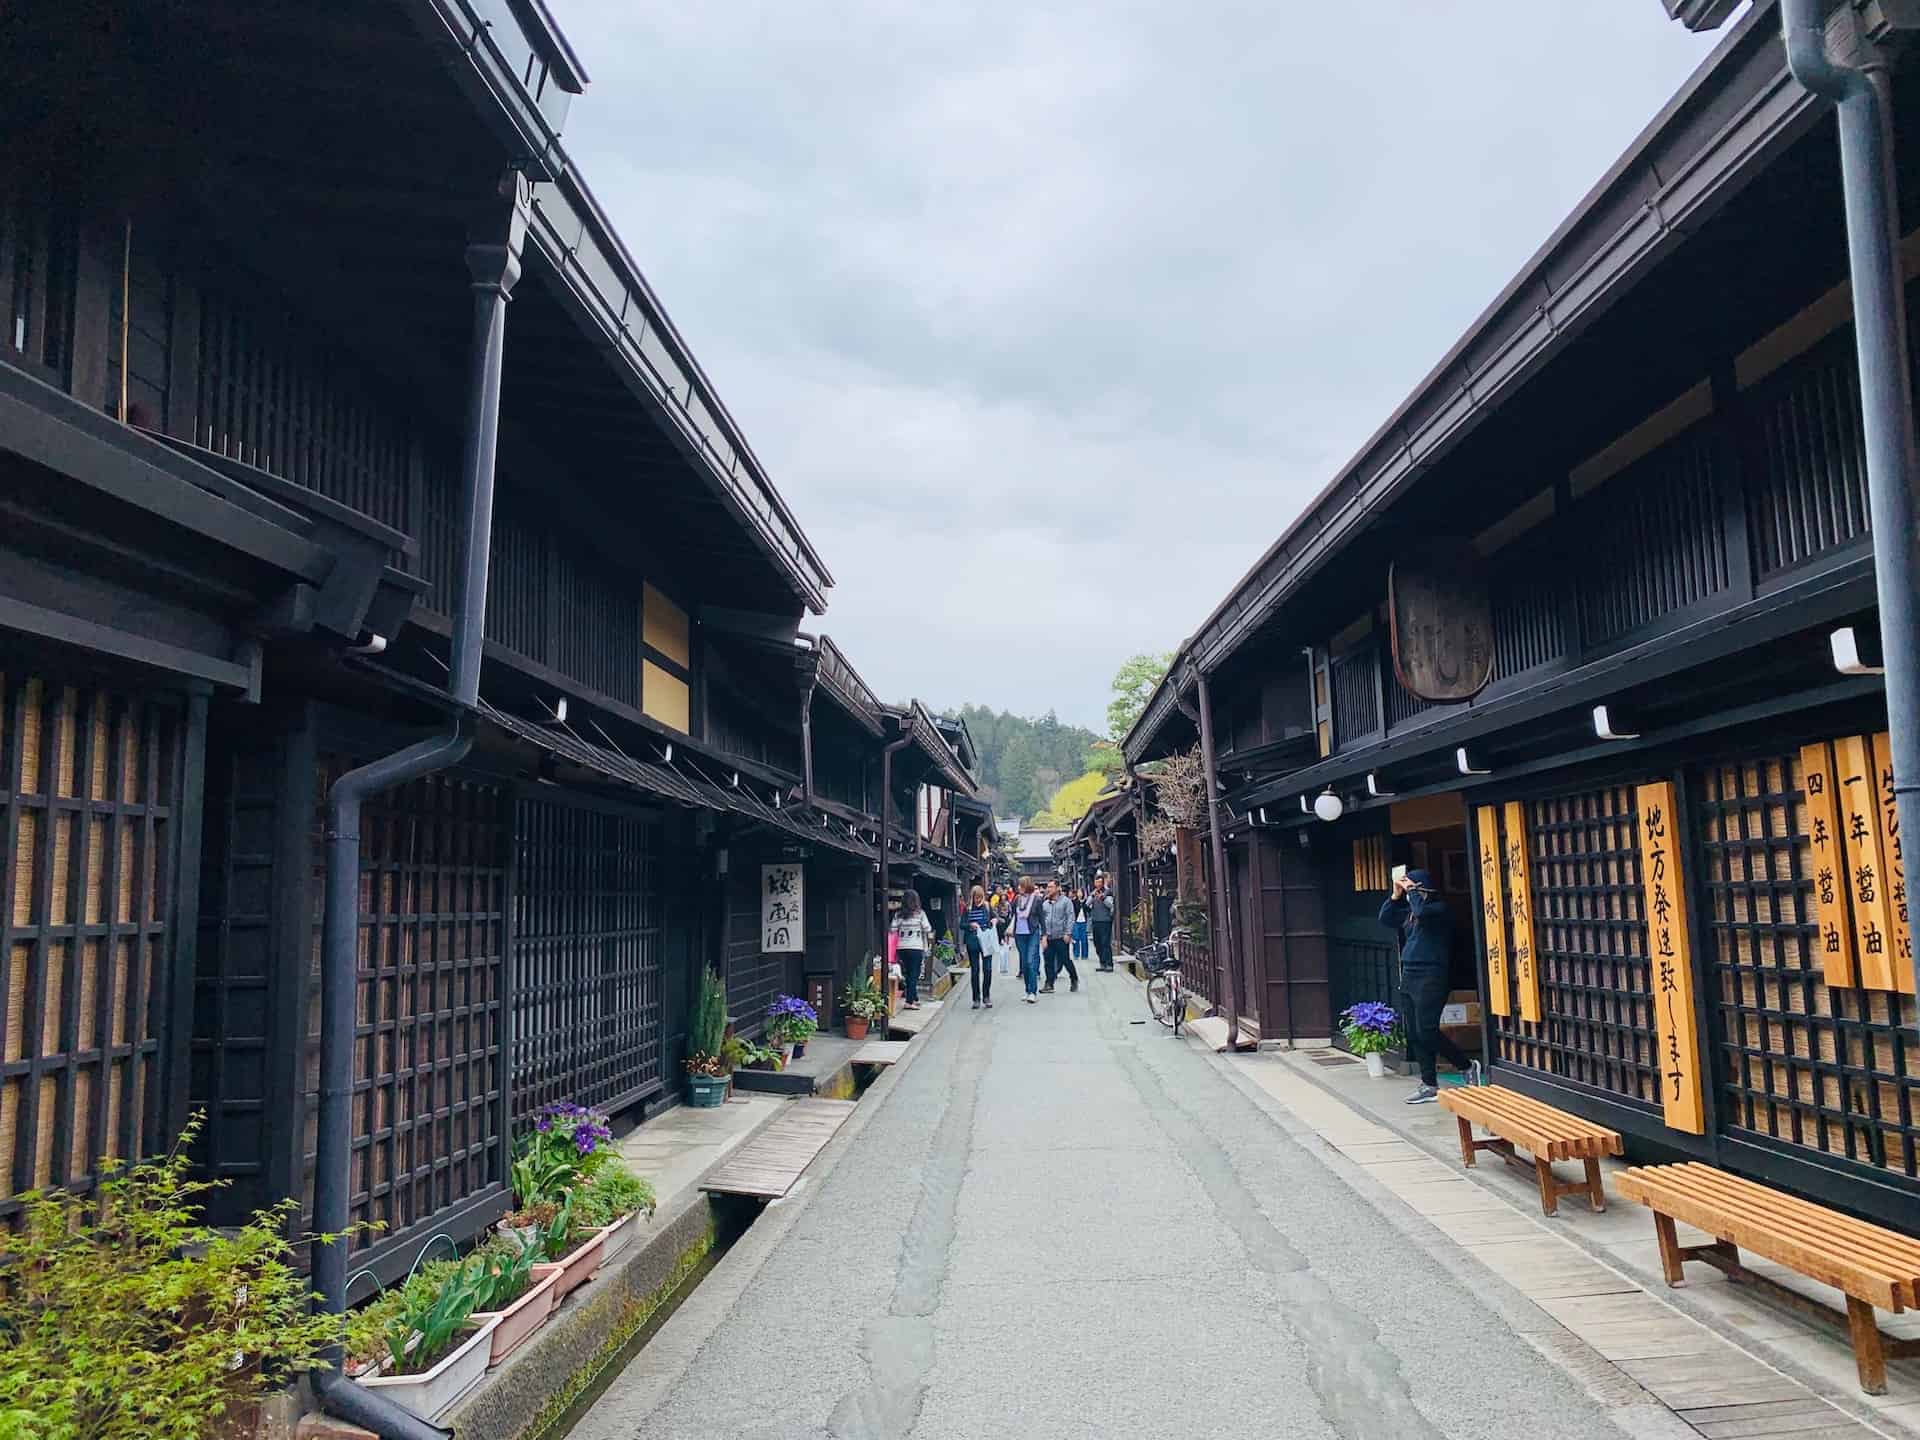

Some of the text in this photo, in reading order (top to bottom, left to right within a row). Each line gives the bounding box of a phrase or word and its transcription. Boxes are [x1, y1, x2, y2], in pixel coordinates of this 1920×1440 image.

[1482, 844, 1500, 975] 赤味噌
[1807, 773, 1840, 952] 四年醤油
[1844, 775, 1883, 954] 一年醤油
[1646, 804, 1684, 1101] 地方発送致します
